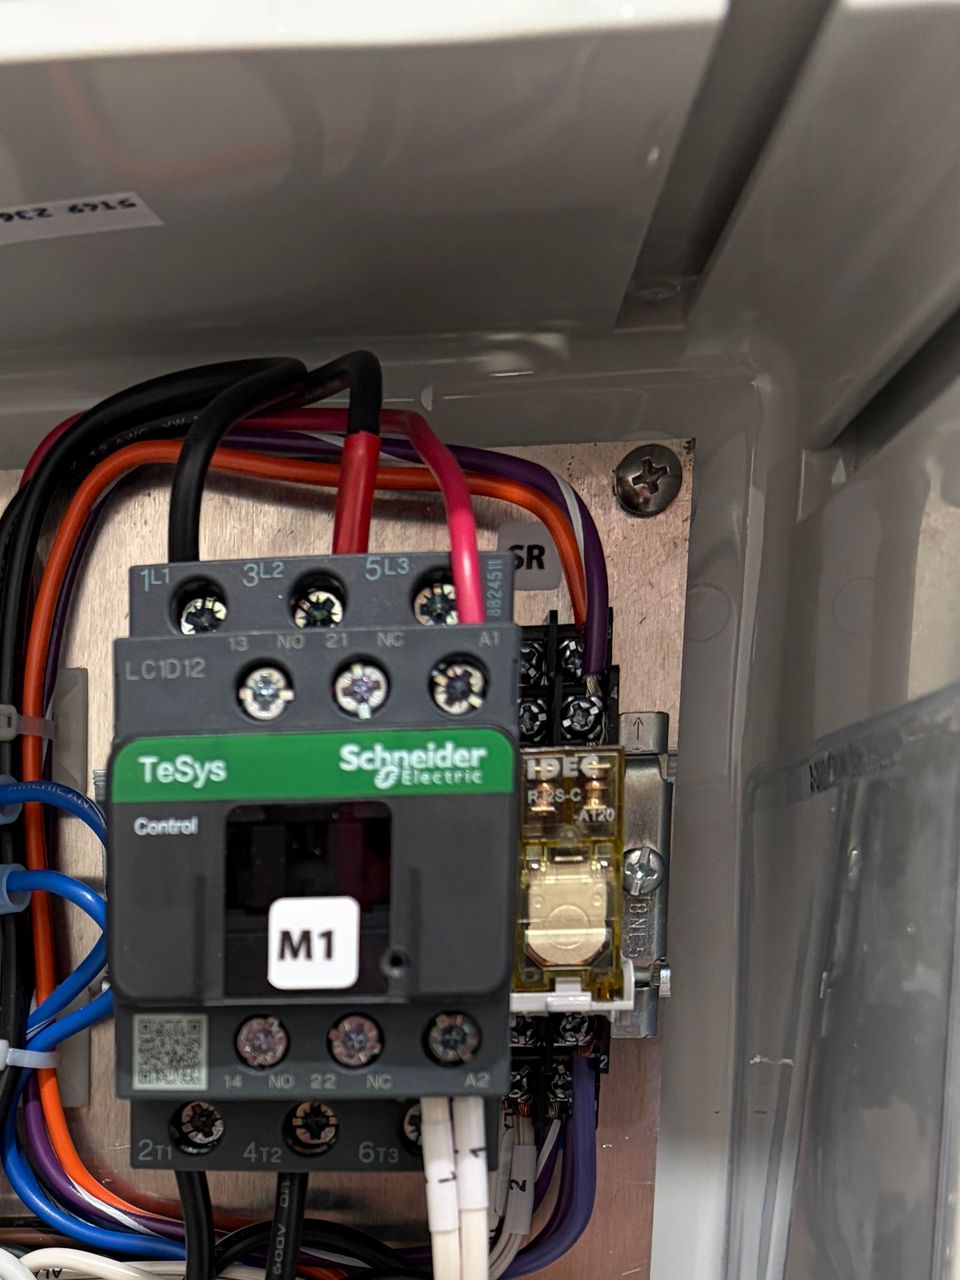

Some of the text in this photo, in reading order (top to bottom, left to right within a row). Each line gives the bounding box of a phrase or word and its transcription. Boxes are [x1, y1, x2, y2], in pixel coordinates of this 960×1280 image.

[508, 544, 546, 570] SR
[228, 637, 248, 651] 13
[277, 635, 305, 649] NO
[325, 633, 348, 648] 21
[377, 632, 404, 647] NC
[478, 631, 501, 646] A1
[125, 658, 207, 681] LC1D12
[339, 741, 489, 772] Schneider
[137, 754, 228, 790] TeSys
[526, 756, 601, 780] IDEC
[400, 770, 483, 785] Electric
[134, 816, 199, 837] Control
[278, 930, 335, 961] M1
[222, 1074, 243, 1090] 14
[268, 1073, 295, 1090] NO
[309, 1074, 337, 1090] 22
[366, 1073, 393, 1090] NC
[464, 1072, 491, 1089] A2
[138, 1139, 174, 1162] 2T1
[243, 1142, 282, 1164] 4T2
[358, 1141, 400, 1164] 6T3
[510, 1179, 527, 1192] 2
[272, 1223, 286, 1275] 600V
